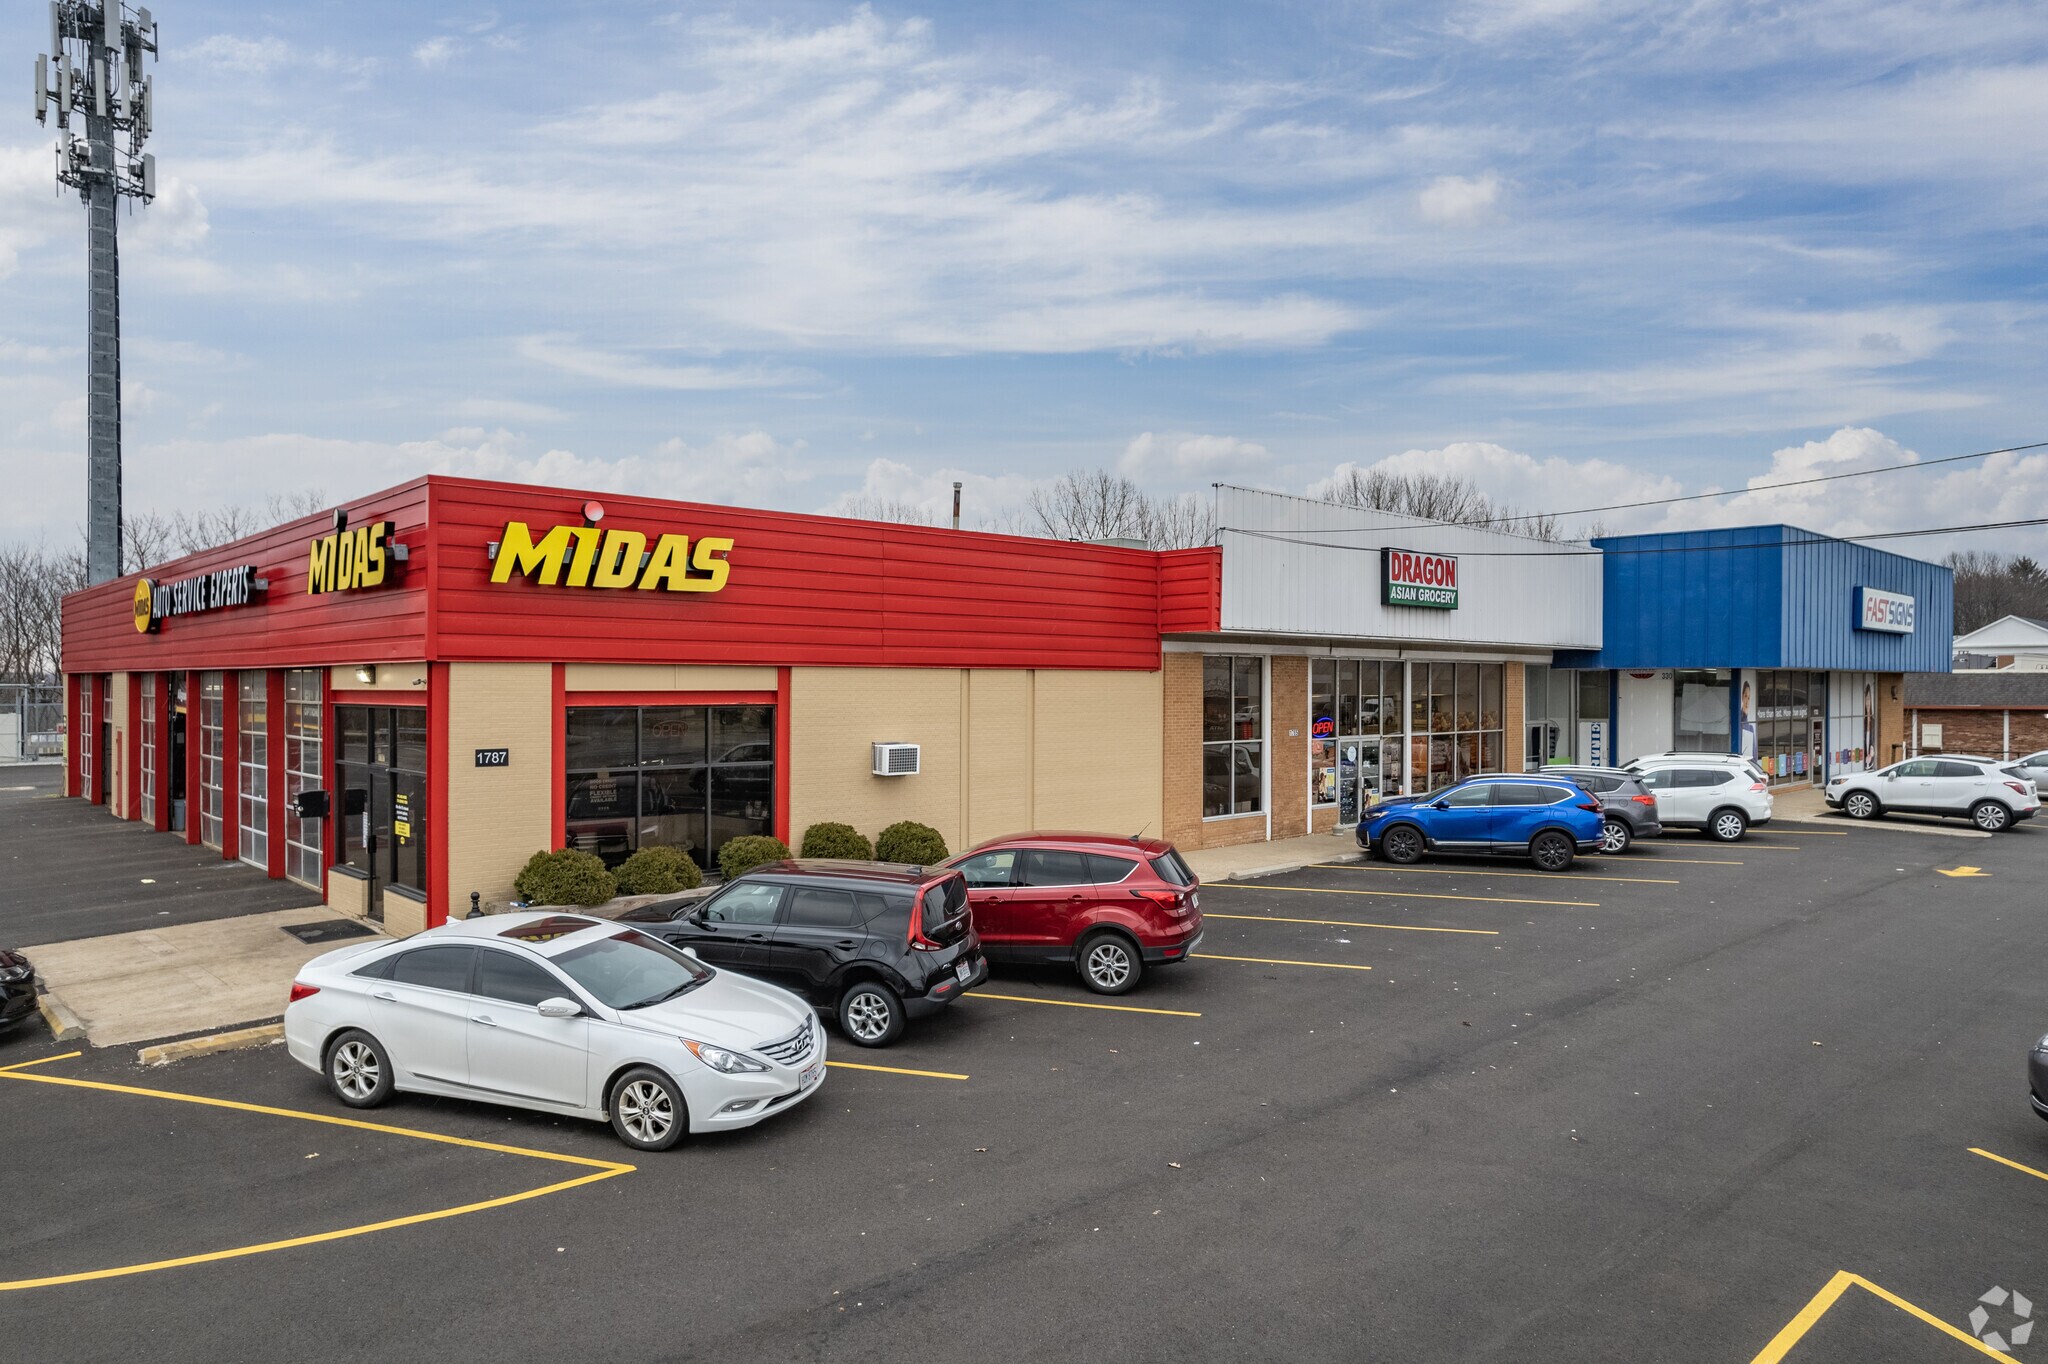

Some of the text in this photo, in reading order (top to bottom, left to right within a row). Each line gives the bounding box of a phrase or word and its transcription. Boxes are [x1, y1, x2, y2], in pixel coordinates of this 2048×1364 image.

[308, 521, 386, 595] MIDAS
[490, 521, 735, 593] MIDAS
[1391, 552, 1456, 587] DRAGON
[152, 564, 250, 619] AUTO SERVICE EXPERTS
[1390, 586, 1456, 604] ASIAN GROCERY
[134, 597, 150, 617] MIDAS
[1661, 672, 1673, 680] 330
[652, 723, 689, 738] OPEN
[1312, 721, 1335, 735] OPEN
[476, 751, 507, 764] 1787
